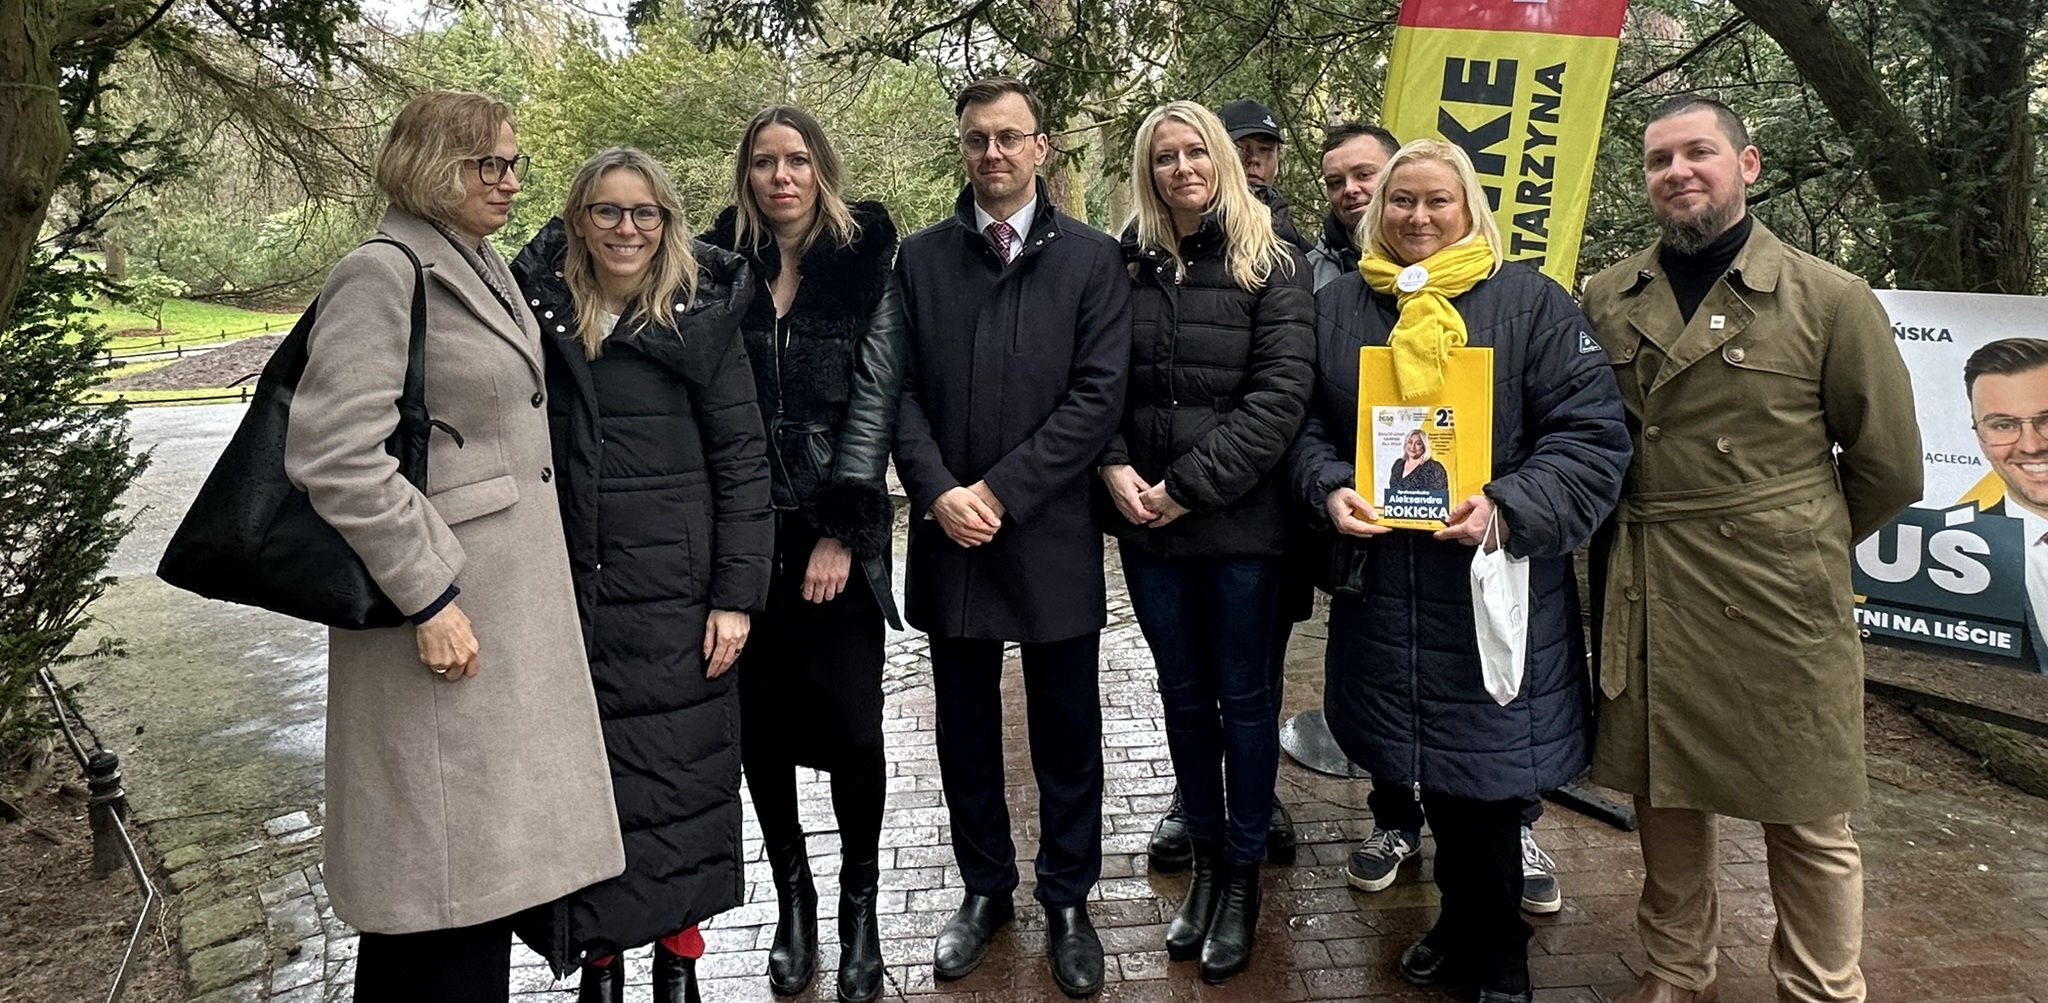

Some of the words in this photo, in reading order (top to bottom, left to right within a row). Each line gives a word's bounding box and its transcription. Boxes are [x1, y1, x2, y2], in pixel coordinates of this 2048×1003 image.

[1436, 409, 1449, 427] 2
[1925, 453, 1982, 467] ĄCLECIA
[1389, 495, 1443, 505] Aleksandra
[1384, 505, 1448, 519] ROKICKA
[1855, 506, 1990, 595] UŚ
[1893, 614, 1931, 636] NA
[1934, 621, 2012, 649] LIŚCIE
